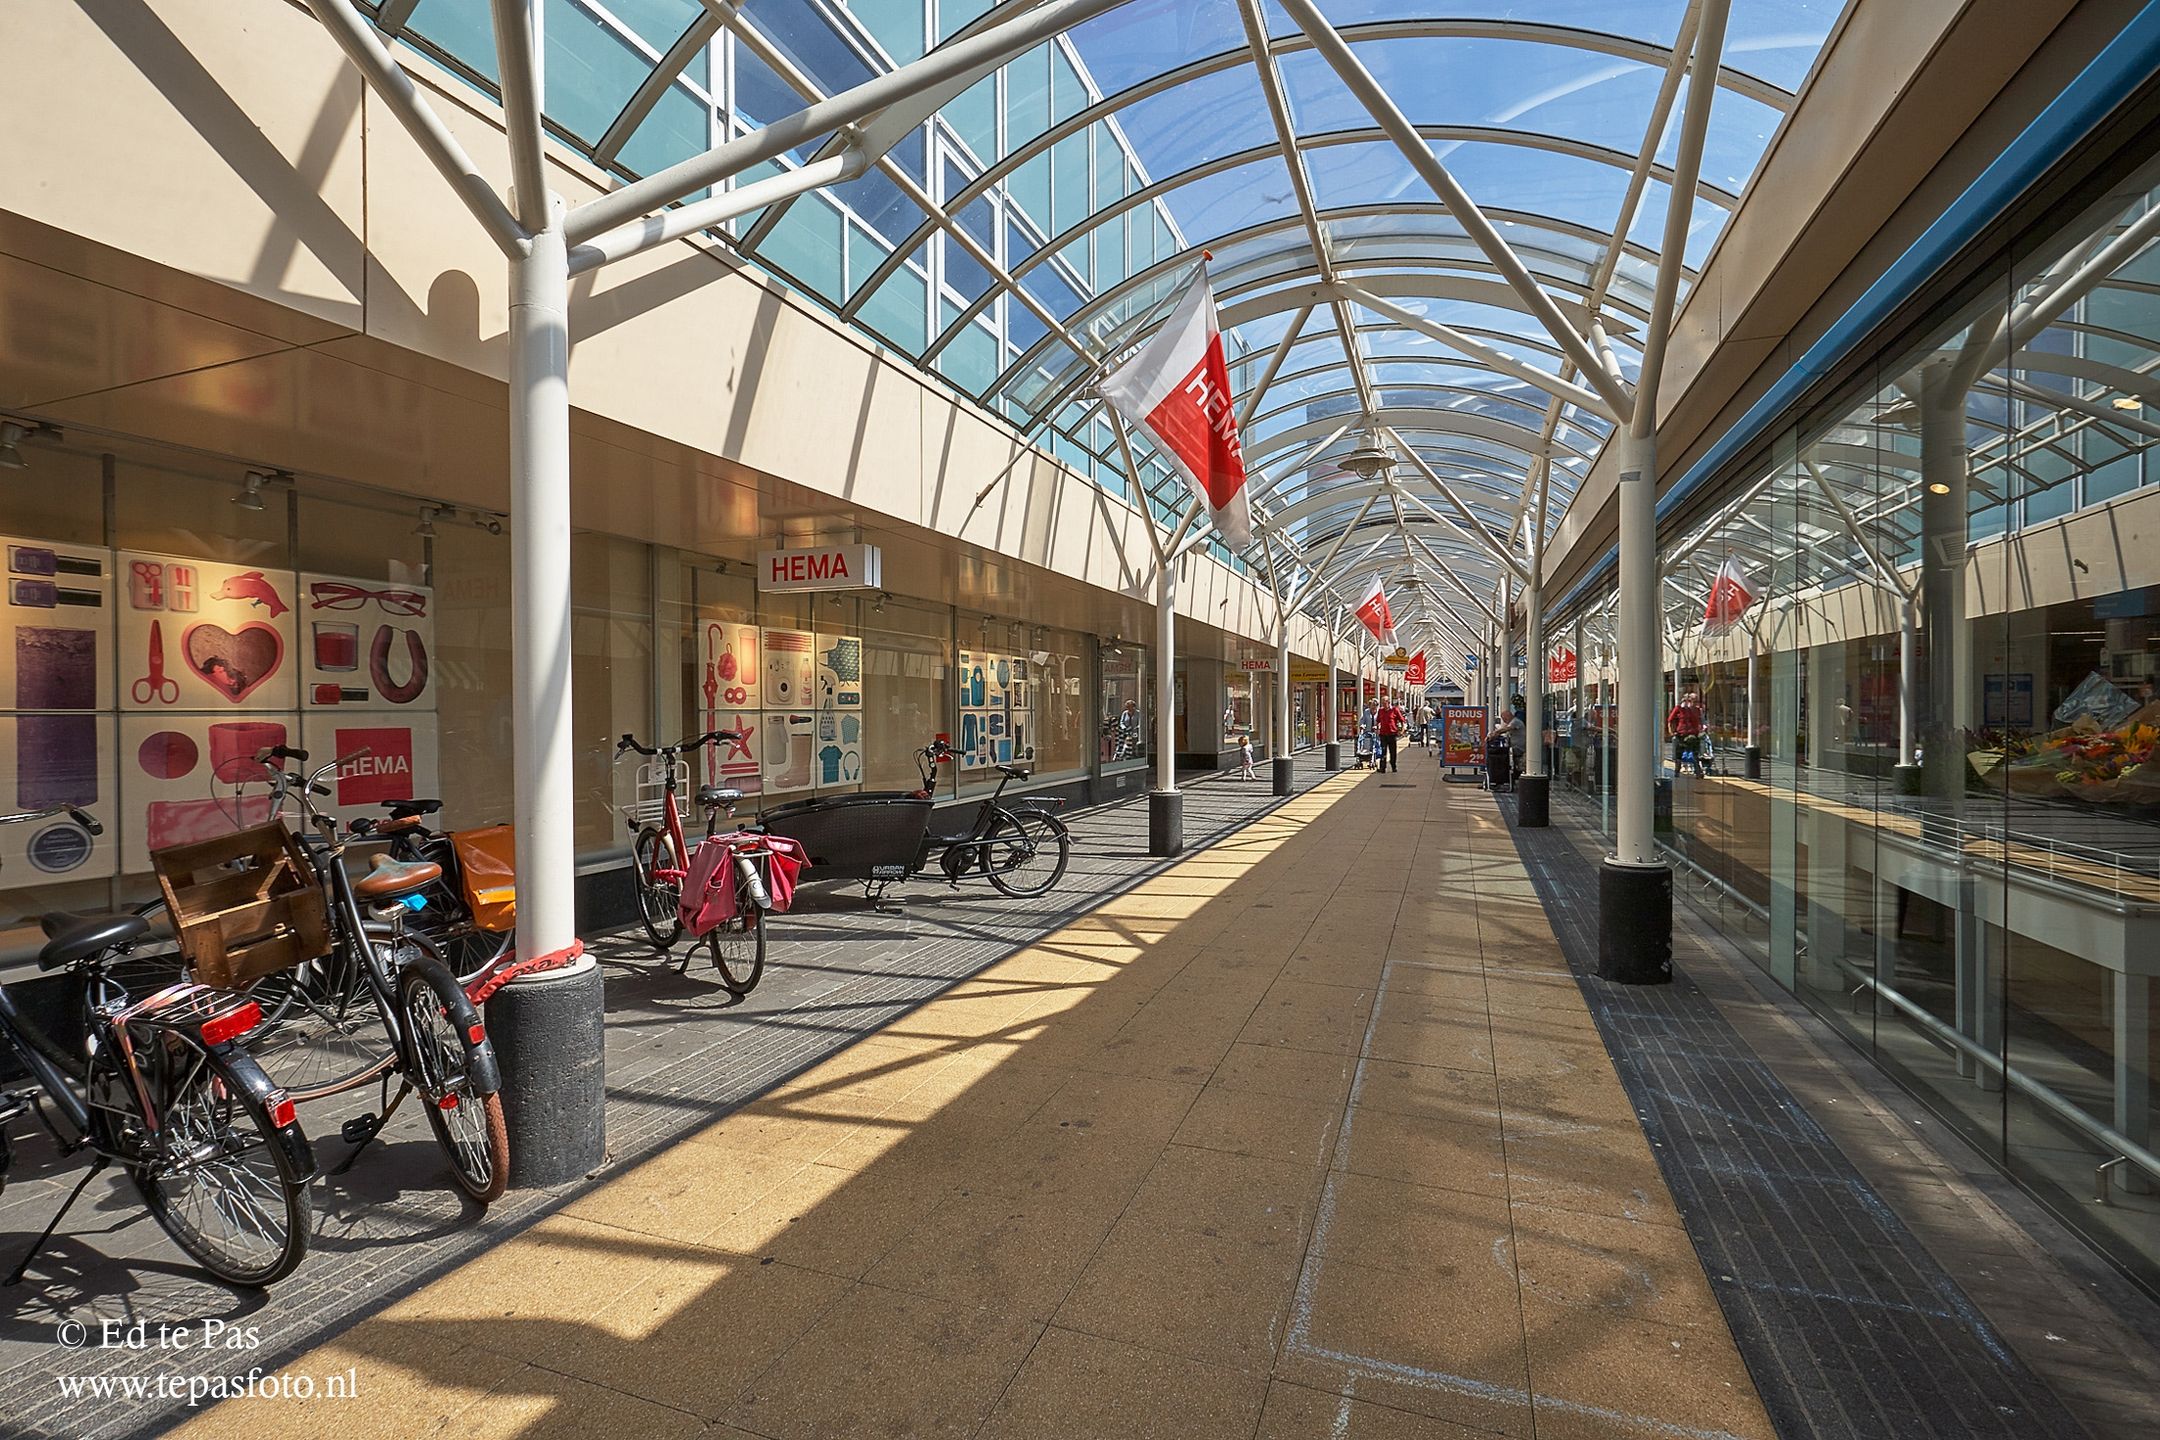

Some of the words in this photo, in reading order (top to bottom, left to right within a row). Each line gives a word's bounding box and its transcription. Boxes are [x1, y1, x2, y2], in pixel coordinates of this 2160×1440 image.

[772, 552, 849, 582] HEMA
[1241, 660, 1271, 670] HEMA
[1448, 709, 1484, 718] BONUS
[342, 755, 409, 777] HEMA
